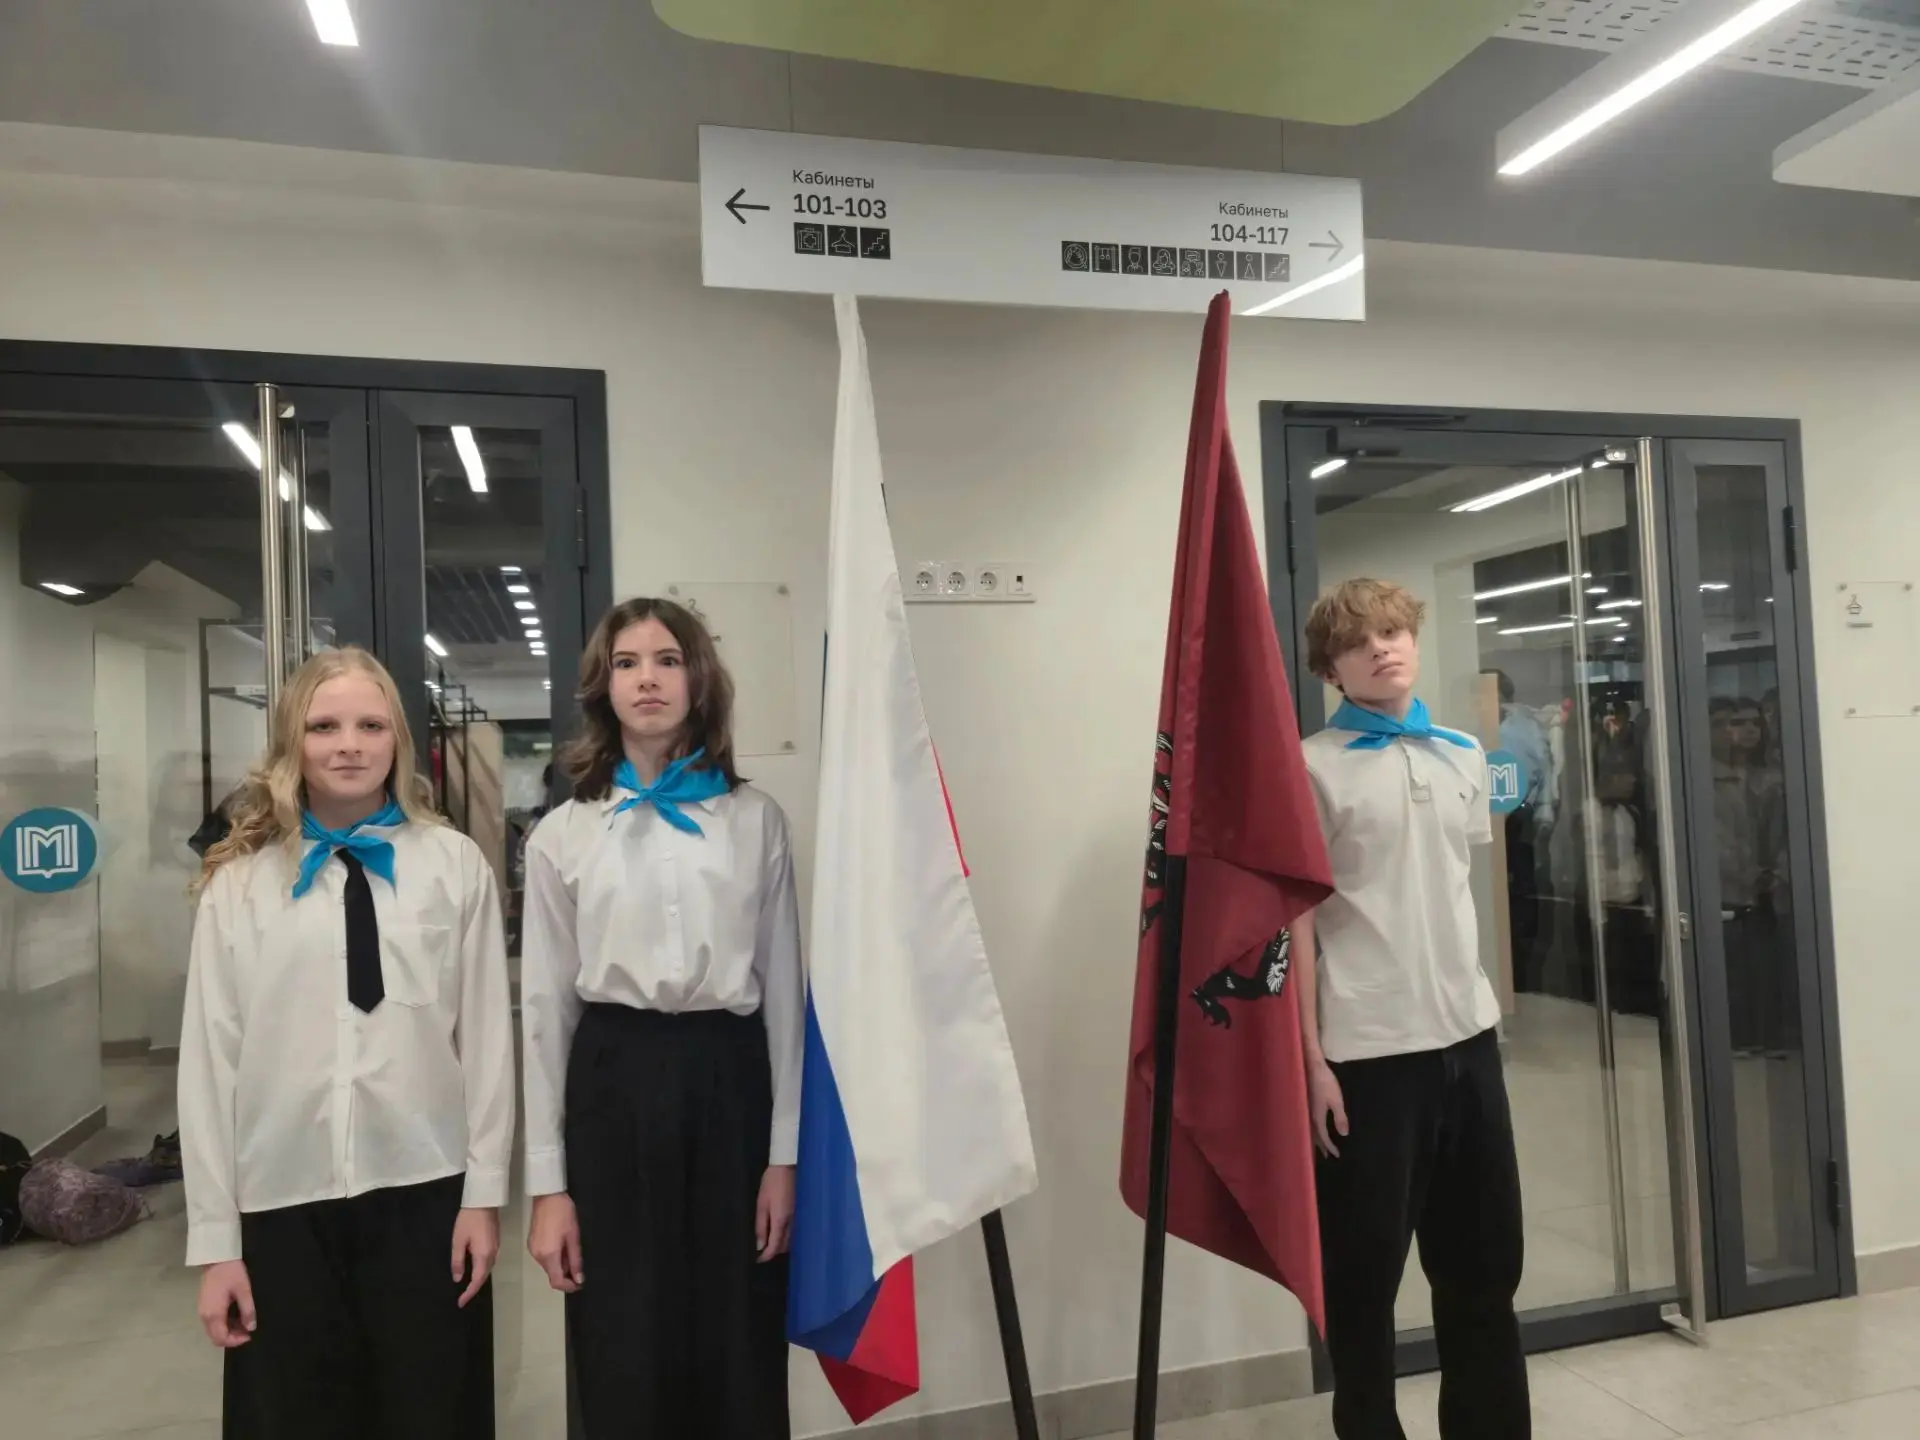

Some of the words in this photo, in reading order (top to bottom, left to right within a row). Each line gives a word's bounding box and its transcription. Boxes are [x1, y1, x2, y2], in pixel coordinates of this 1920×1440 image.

[793, 169, 874, 189] Кабинеты
[794, 193, 887, 219] 101-103
[1219, 202, 1289, 219] Кабинеты
[1211, 224, 1289, 245] 104-117
